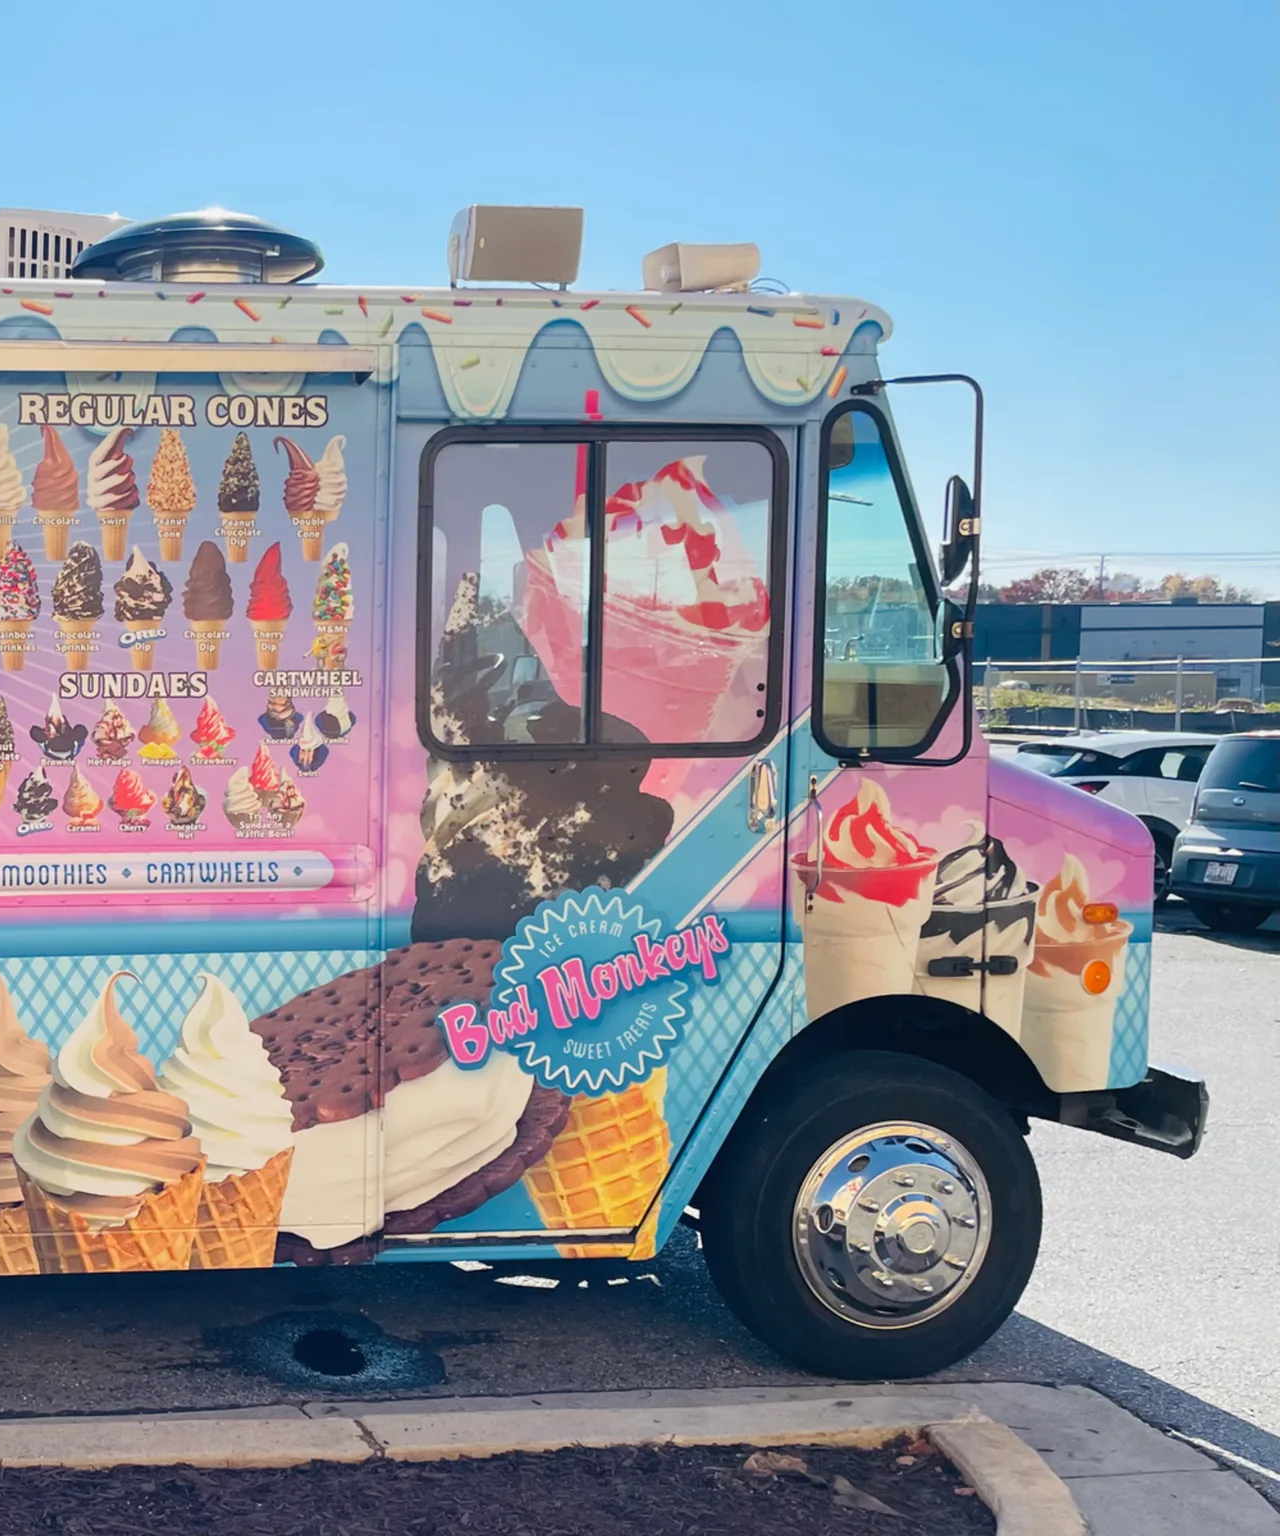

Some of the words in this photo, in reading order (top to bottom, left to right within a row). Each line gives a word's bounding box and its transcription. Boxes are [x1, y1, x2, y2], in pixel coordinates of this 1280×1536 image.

[19, 393, 196, 427] REGULAR
[206, 395, 329, 428] CONES
[32, 516, 81, 526] Chocolate
[100, 516, 126, 526] Swirl
[152, 517, 187, 526] Peanut
[221, 518, 256, 528] Peanut
[292, 516, 326, 527] Double
[157, 529, 181, 539] Cone
[214, 527, 262, 538] Chocolate
[296, 529, 321, 539] Cone
[229, 537, 247, 547] Dip
[53, 630, 101, 640] Chocolate
[119, 628, 167, 646] OREO
[183, 630, 231, 640] Chocolate
[253, 630, 284, 640] Cherry
[55, 643, 101, 652] Sprinkles
[134, 642, 151, 652] Dip
[198, 642, 216, 652] Dip
[260, 642, 277, 652] Dip
[252, 670, 363, 687] CARTWHEEL
[59, 672, 208, 699] SUNDAES
[269, 687, 344, 698] SANDWICHES
[40, 758, 77, 767] Brownie
[87, 758, 104, 767] Hot
[106, 758, 132, 768] Fudge
[141, 758, 182, 768] Pineapple
[190, 757, 239, 767] Strawberry
[265, 812, 283, 822] Any
[66, 824, 101, 833] Caramel
[119, 824, 147, 834] Cherry
[164, 823, 207, 832] Chocolate
[146, 861, 279, 884] CARTWHEELS
[538, 933, 564, 958] ICE
[568, 920, 624, 938] CREAM
[438, 984, 539, 1064] Bad
[536, 914, 729, 1030] Monkeys
[563, 1038, 612, 1060] SWEET
[616, 1001, 657, 1051] TREATS
